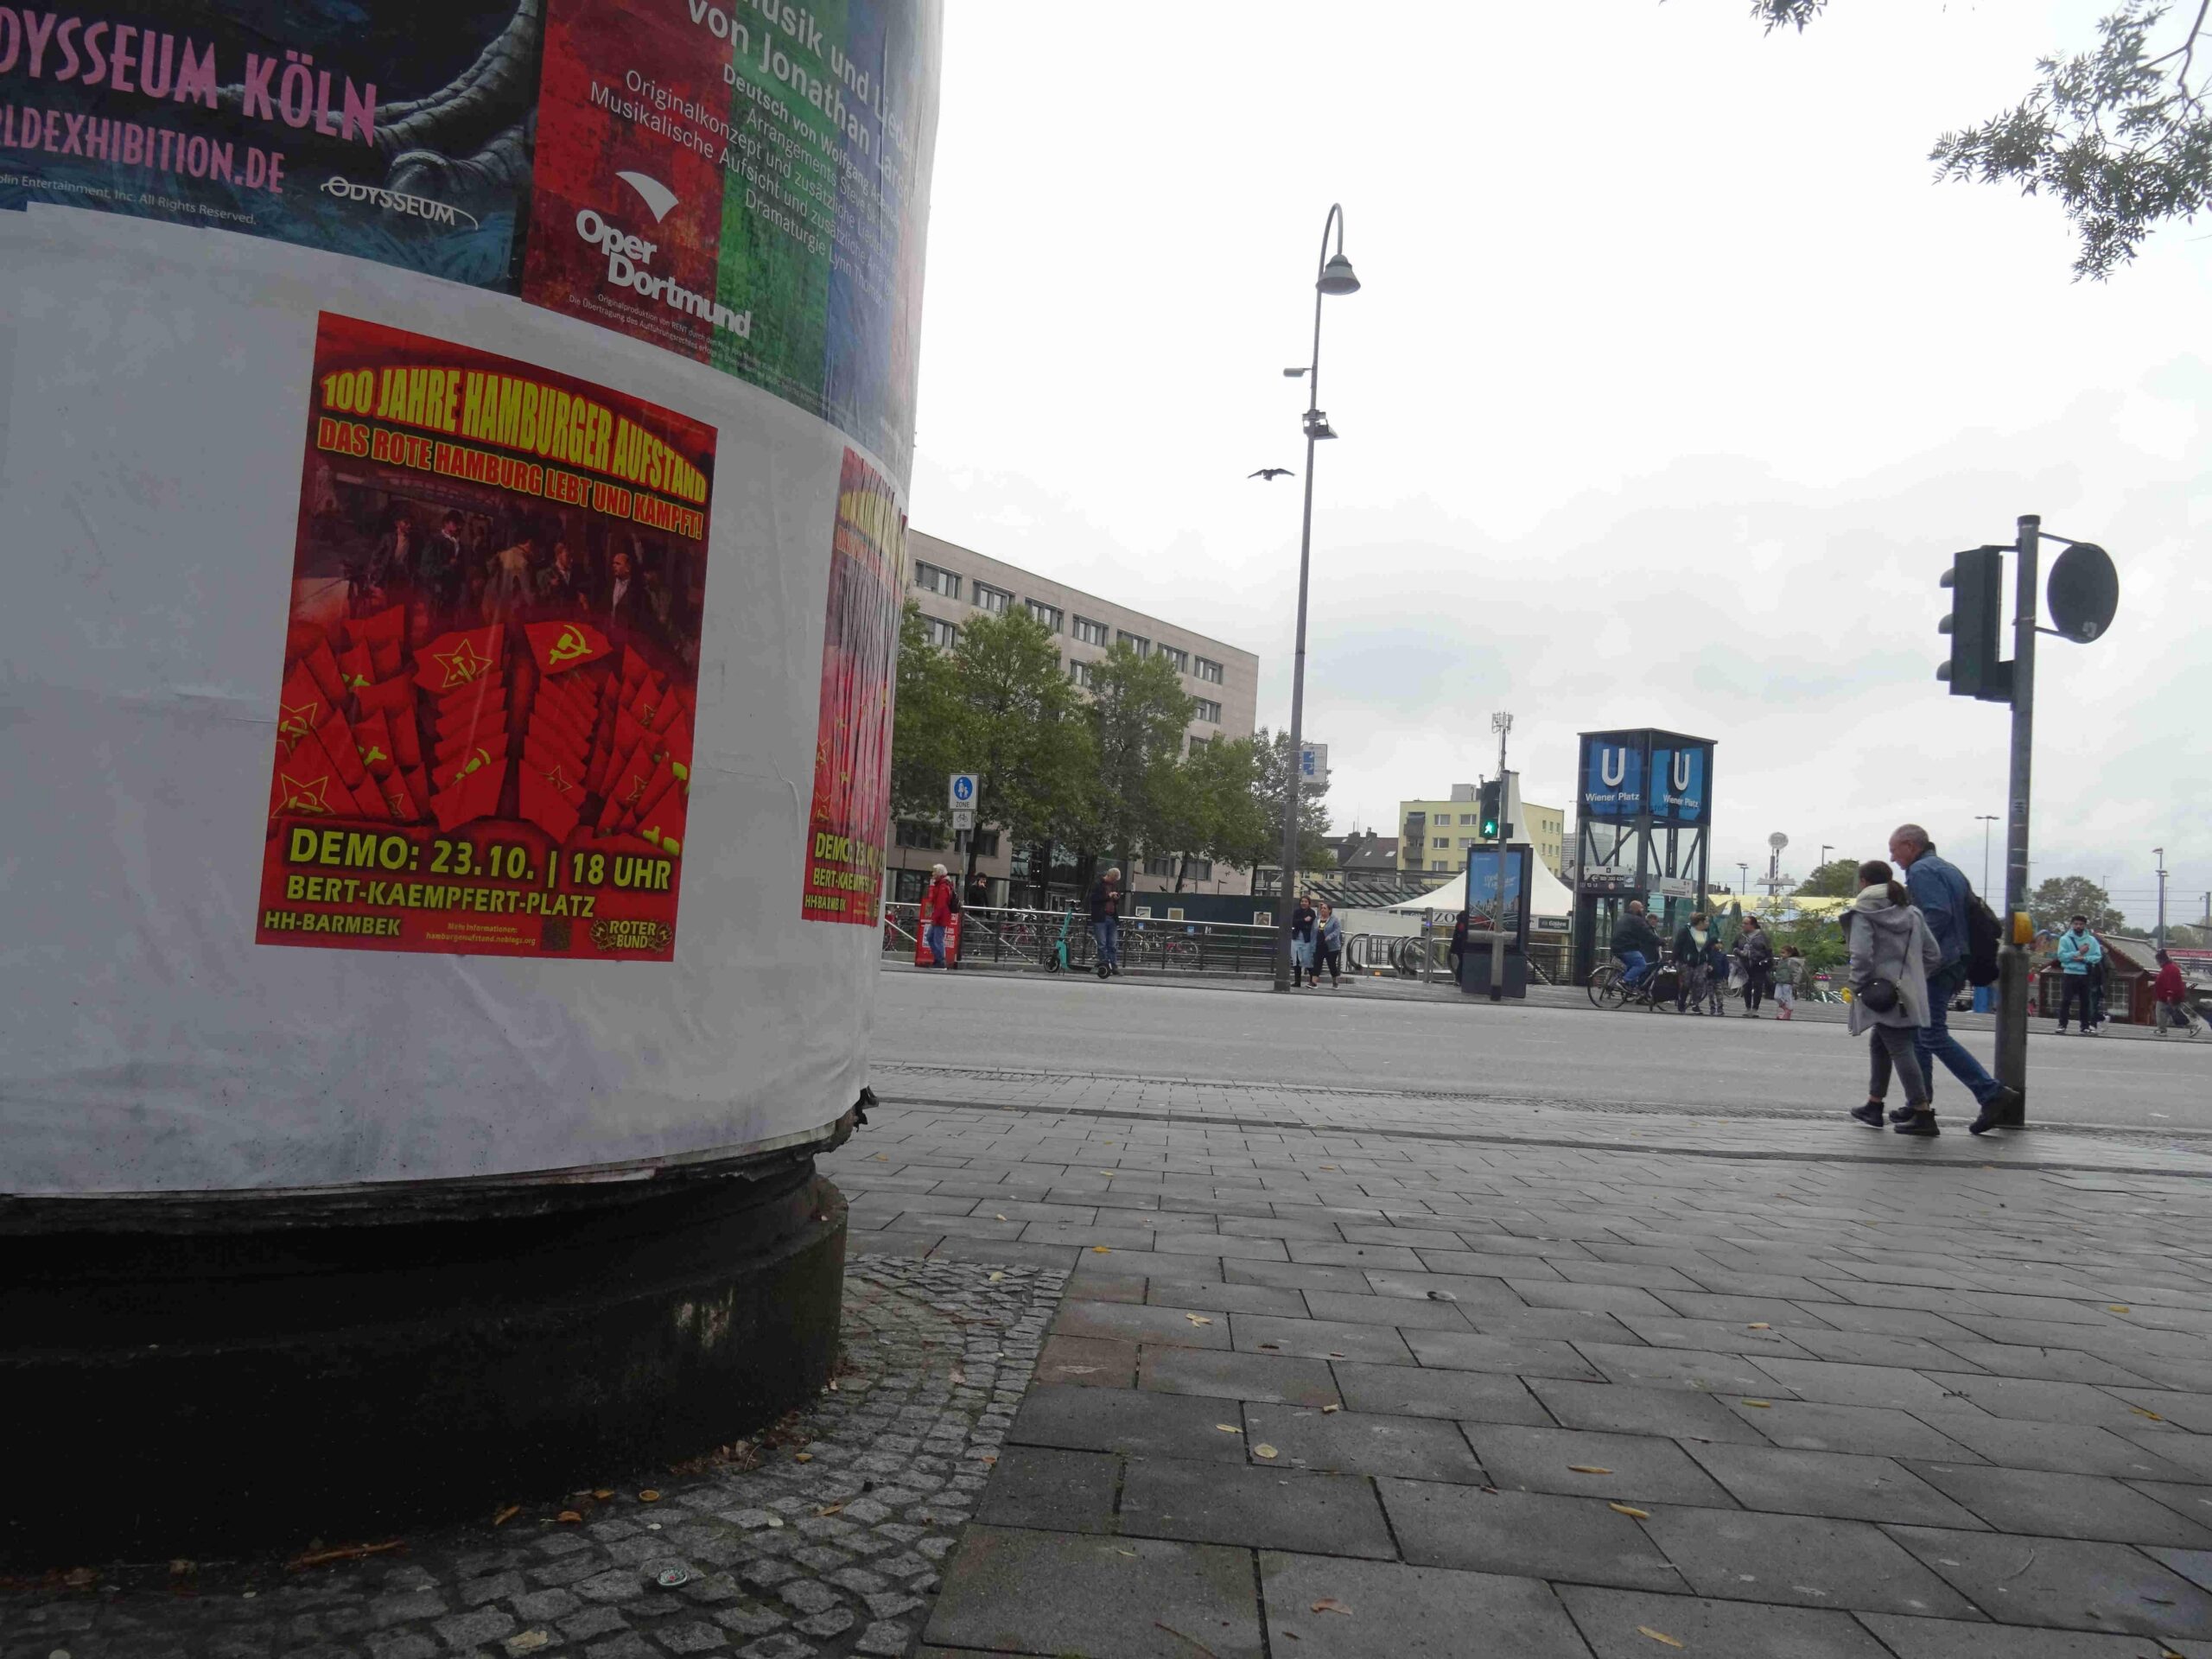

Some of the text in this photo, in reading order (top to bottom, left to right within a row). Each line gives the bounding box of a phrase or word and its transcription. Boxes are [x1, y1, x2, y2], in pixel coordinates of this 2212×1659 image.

[688, 0, 749, 54] von
[759, 32, 870, 156] Jonathan
[740, 0, 823, 58] usik
[831, 44, 869, 101] und
[243, 50, 377, 148] KÖLN
[0, 105, 284, 193] LDEXHIBITION.DE
[626, 70, 761, 160] Originalkonzept
[766, 151, 791, 179] und
[795, 171, 855, 229] zusätzliche
[723, 63, 788, 123] Deutsch
[793, 115, 817, 143] von
[821, 132, 868, 196] Wolfgang
[591, 81, 865, 264] Musikalische Aufsicht und zusätzliche
[747, 108, 836, 187] Arrangements
[840, 176, 865, 213] Steve
[115, 190, 135, 202] Inc.
[139, 194, 155, 205] All
[158, 196, 195, 213] Rights
[199, 204, 257, 226] Reserved.
[321, 176, 467, 228] ODYSSEUM
[575, 209, 657, 264] Oper
[745, 188, 825, 256] Dramaturgie
[830, 244, 852, 276] Lynn
[569, 295, 581, 306] Die
[583, 297, 625, 322] Übertragung
[598, 293, 658, 322] Originalproduktion
[671, 321, 689, 334] RENT
[608, 252, 751, 340] Dortmund
[323, 369, 707, 504] 100 JAHRE HAMBURGER AUFSTAND
[318, 416, 704, 540] DAS ROTE HAMBURG LEBT UND KÄMPFT!
[1601, 747, 1625, 786] U
[1674, 752, 1690, 791] U
[1585, 791, 1640, 802] Wiener Platz
[1662, 794, 1700, 808] Wiener Platz
[289, 828, 419, 871] DEMO:
[430, 840, 534, 880] 23.10.
[573, 853, 604, 885] 18
[613, 856, 671, 890] UHR
[264, 911, 401, 936] HH-BARMBEK
[287, 875, 595, 918] BERT-KAEMPFERT-PLATZ
[609, 919, 658, 936] ROTER
[616, 935, 648, 949] BUND
